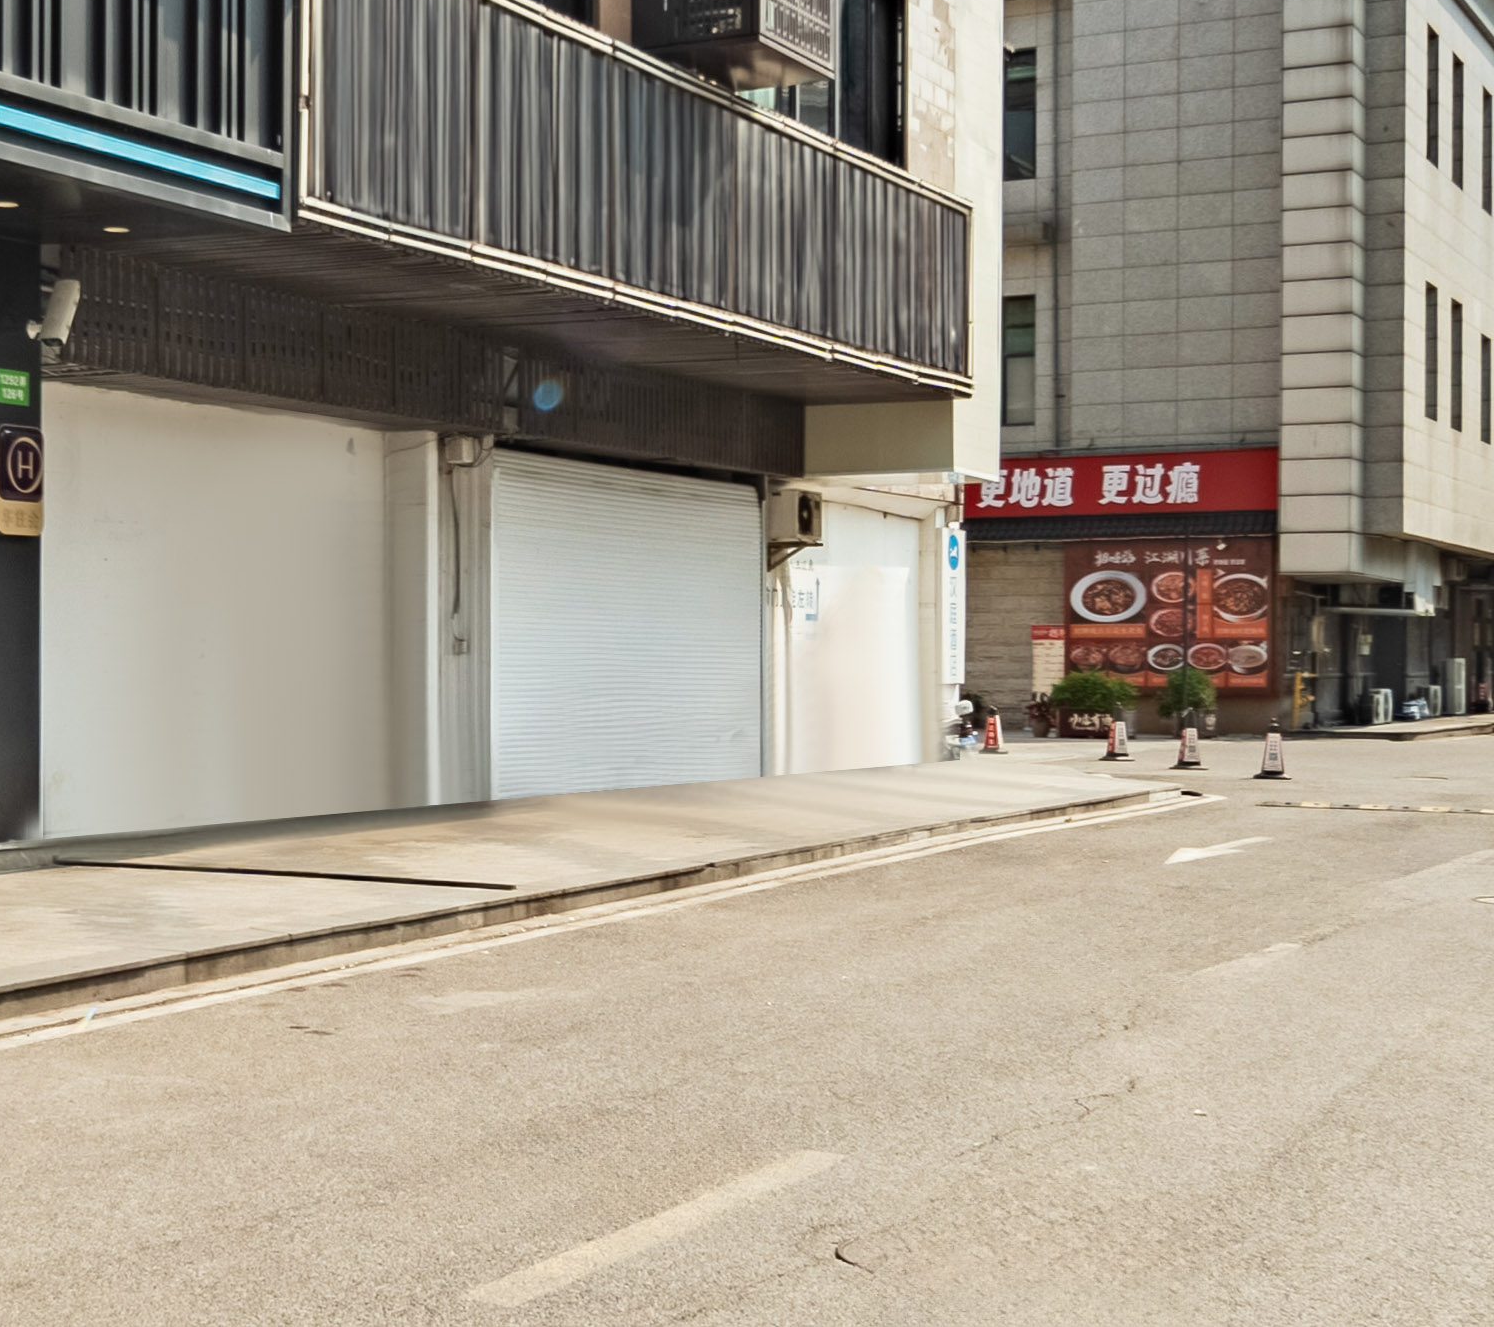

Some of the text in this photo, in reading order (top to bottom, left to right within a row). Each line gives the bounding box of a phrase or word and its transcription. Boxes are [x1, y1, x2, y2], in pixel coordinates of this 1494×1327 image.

[976, 461, 1201, 508] 更地道 更过瘾
